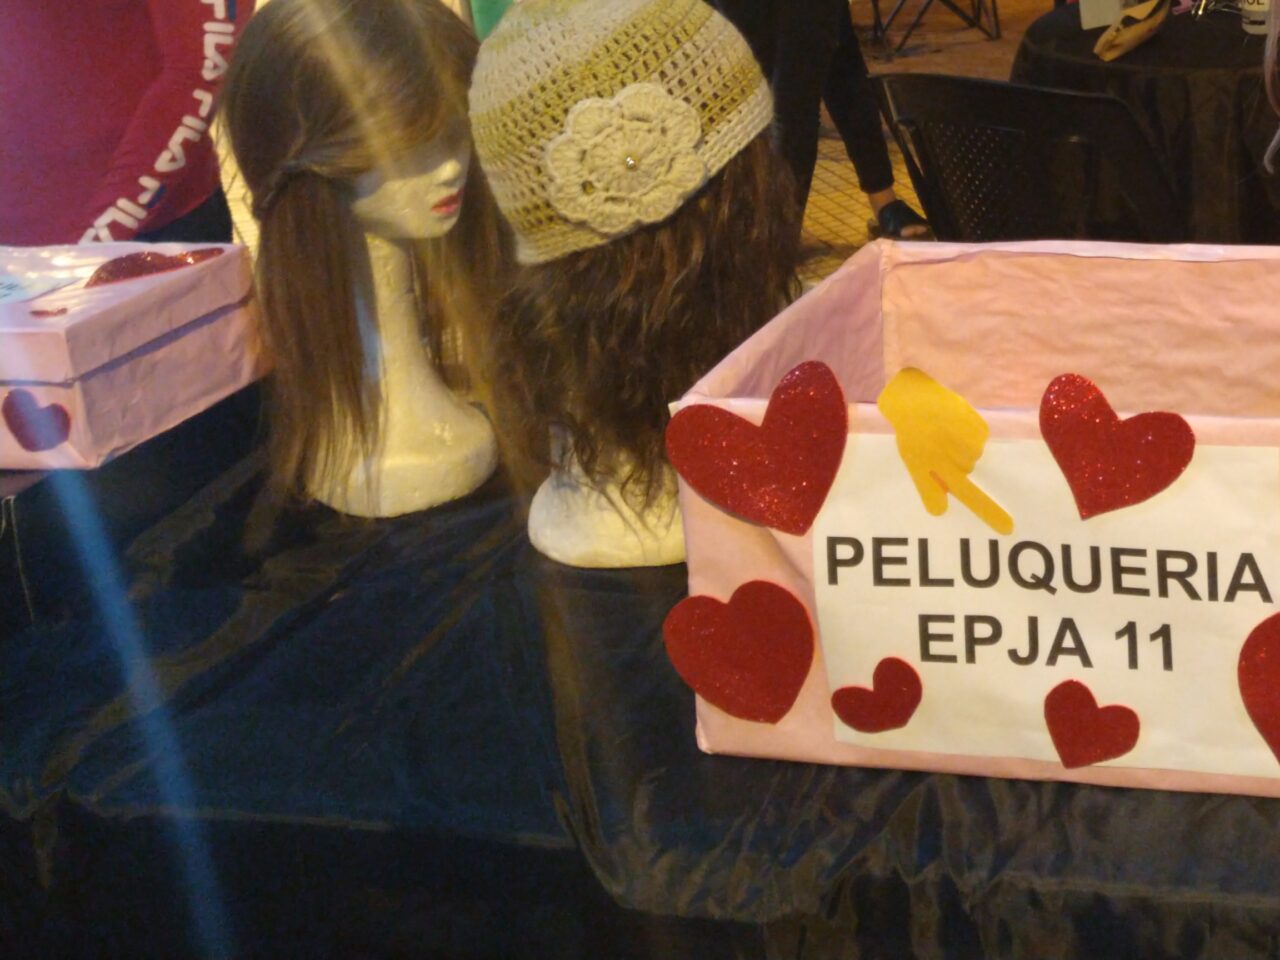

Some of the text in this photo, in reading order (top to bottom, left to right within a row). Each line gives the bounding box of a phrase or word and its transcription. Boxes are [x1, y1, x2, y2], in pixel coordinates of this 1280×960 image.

[825, 536, 1274, 606] PELUQUERIA
[918, 613, 1174, 673] EPJA 11
